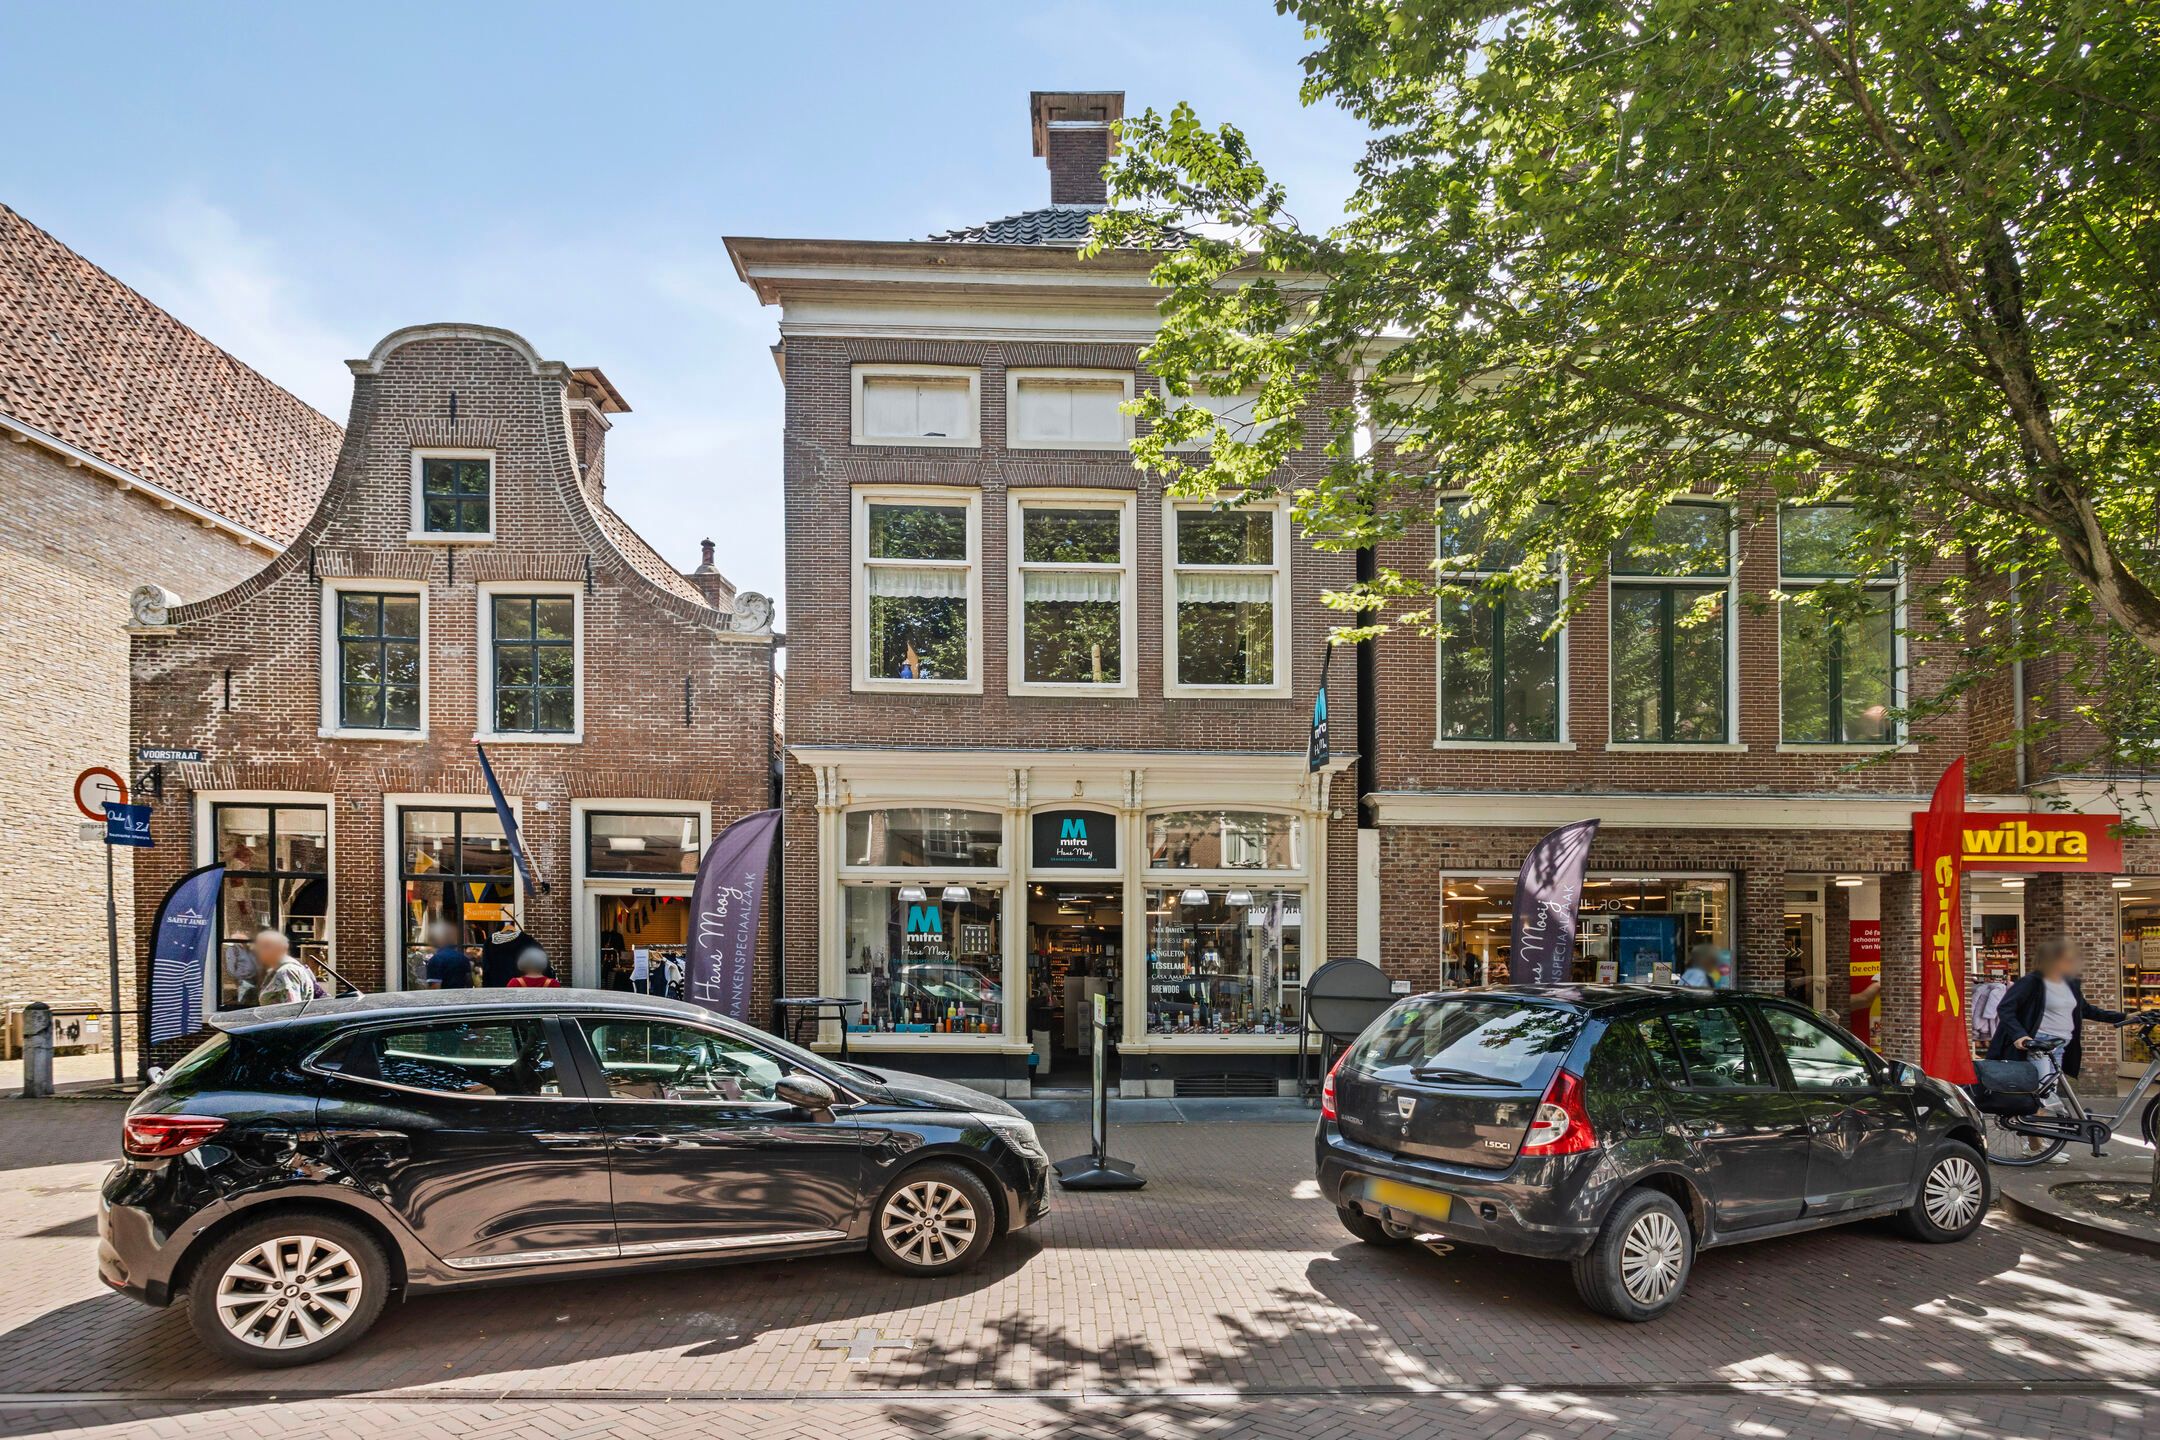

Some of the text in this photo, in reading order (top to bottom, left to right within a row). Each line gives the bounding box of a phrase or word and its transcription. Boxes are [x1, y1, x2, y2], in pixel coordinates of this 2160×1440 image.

[143, 750, 199, 760] VOORSTRAAT
[1061, 818, 1087, 838] M
[1060, 838, 1087, 846] mitra
[1963, 821, 2088, 855] wibra
[907, 905, 943, 932] M
[907, 932, 943, 942] mitra
[1552, 884, 1575, 984] NSPECIAALZAAK
[730, 872, 757, 1020] RANKENSPECIAALZAAK
[1151, 949, 1186, 957] SINGLETON
[1152, 962, 1186, 970] TESSELAAR
[1863, 964, 1881, 972] echt
[694, 949, 723, 1002] Hans
[1151, 985, 1180, 993] BREWDOG
